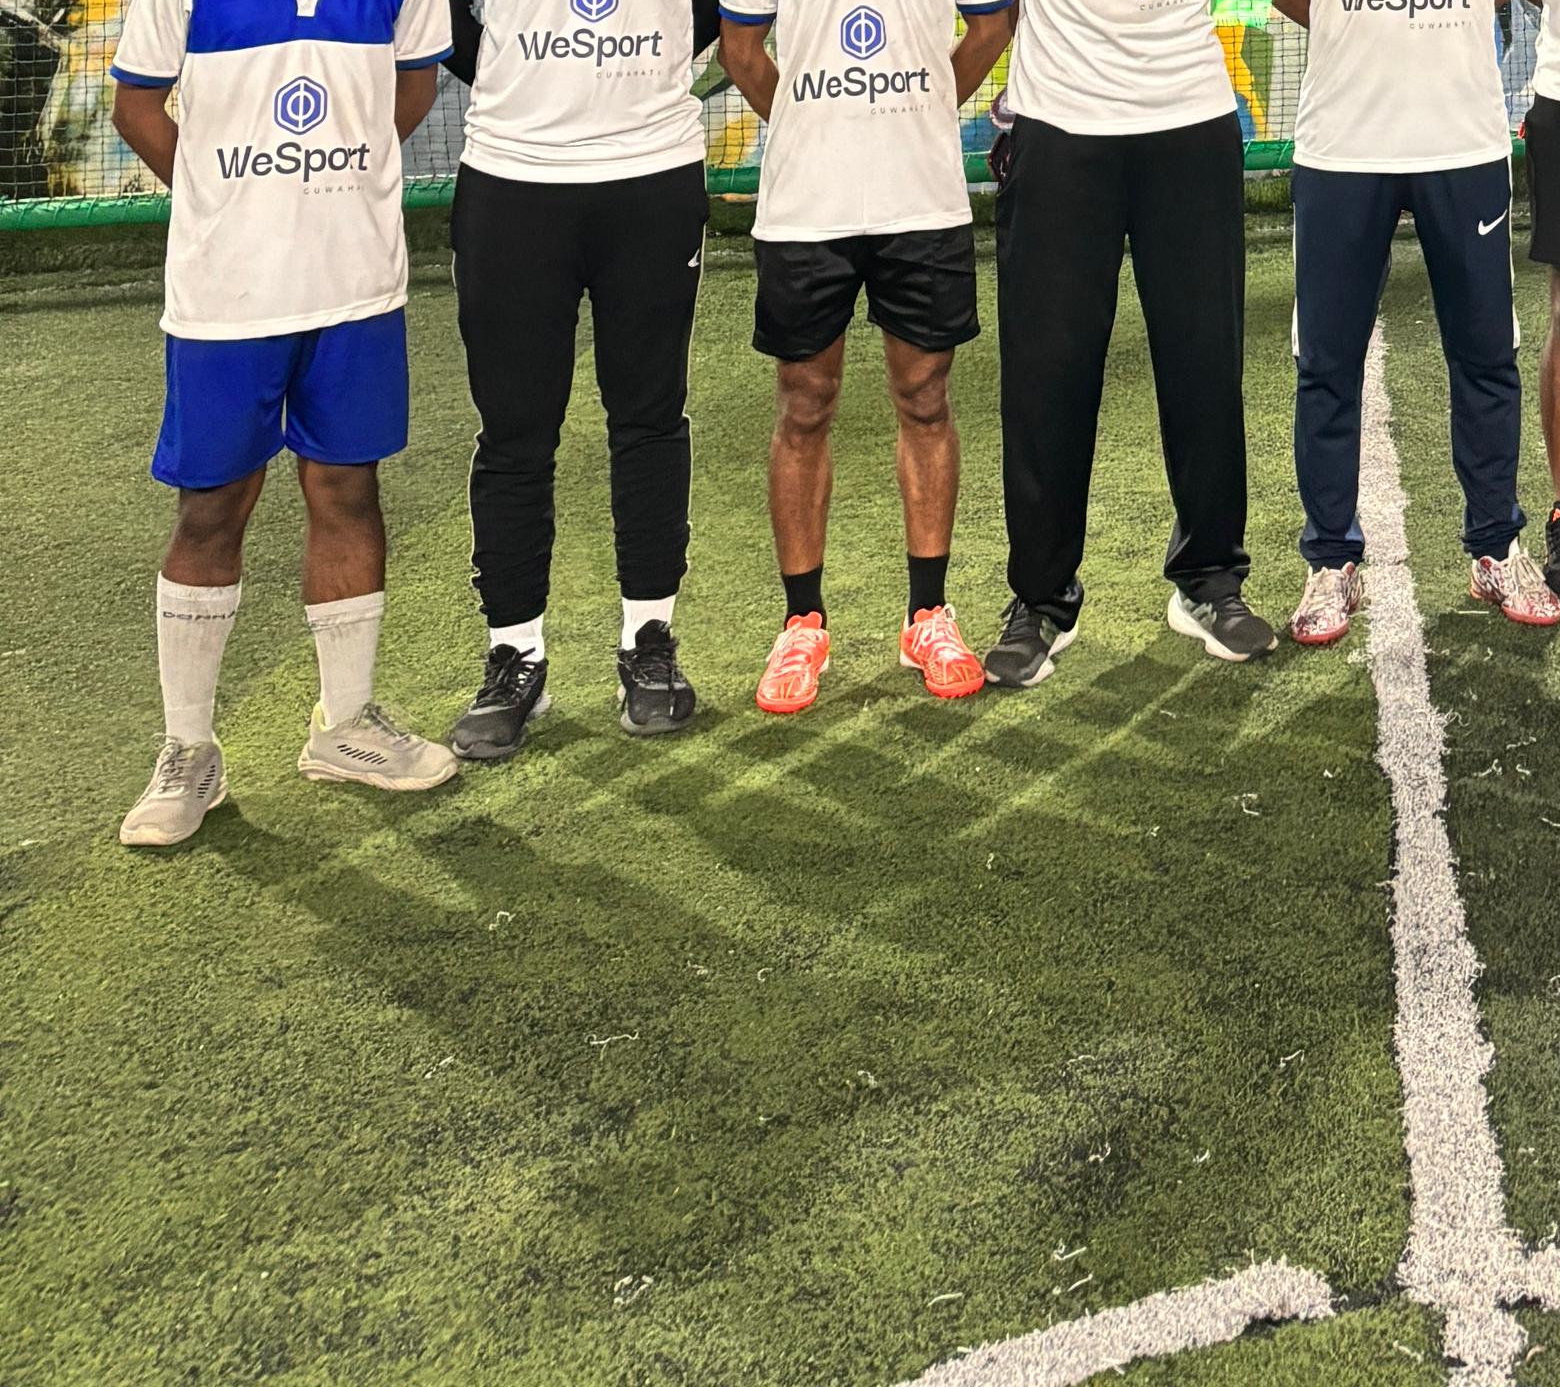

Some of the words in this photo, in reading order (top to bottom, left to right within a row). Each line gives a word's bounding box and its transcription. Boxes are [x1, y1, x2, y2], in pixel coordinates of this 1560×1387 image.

[517, 29, 663, 67] WeSport
[793, 67, 930, 104] WeSport
[217, 142, 370, 183] WeSport
